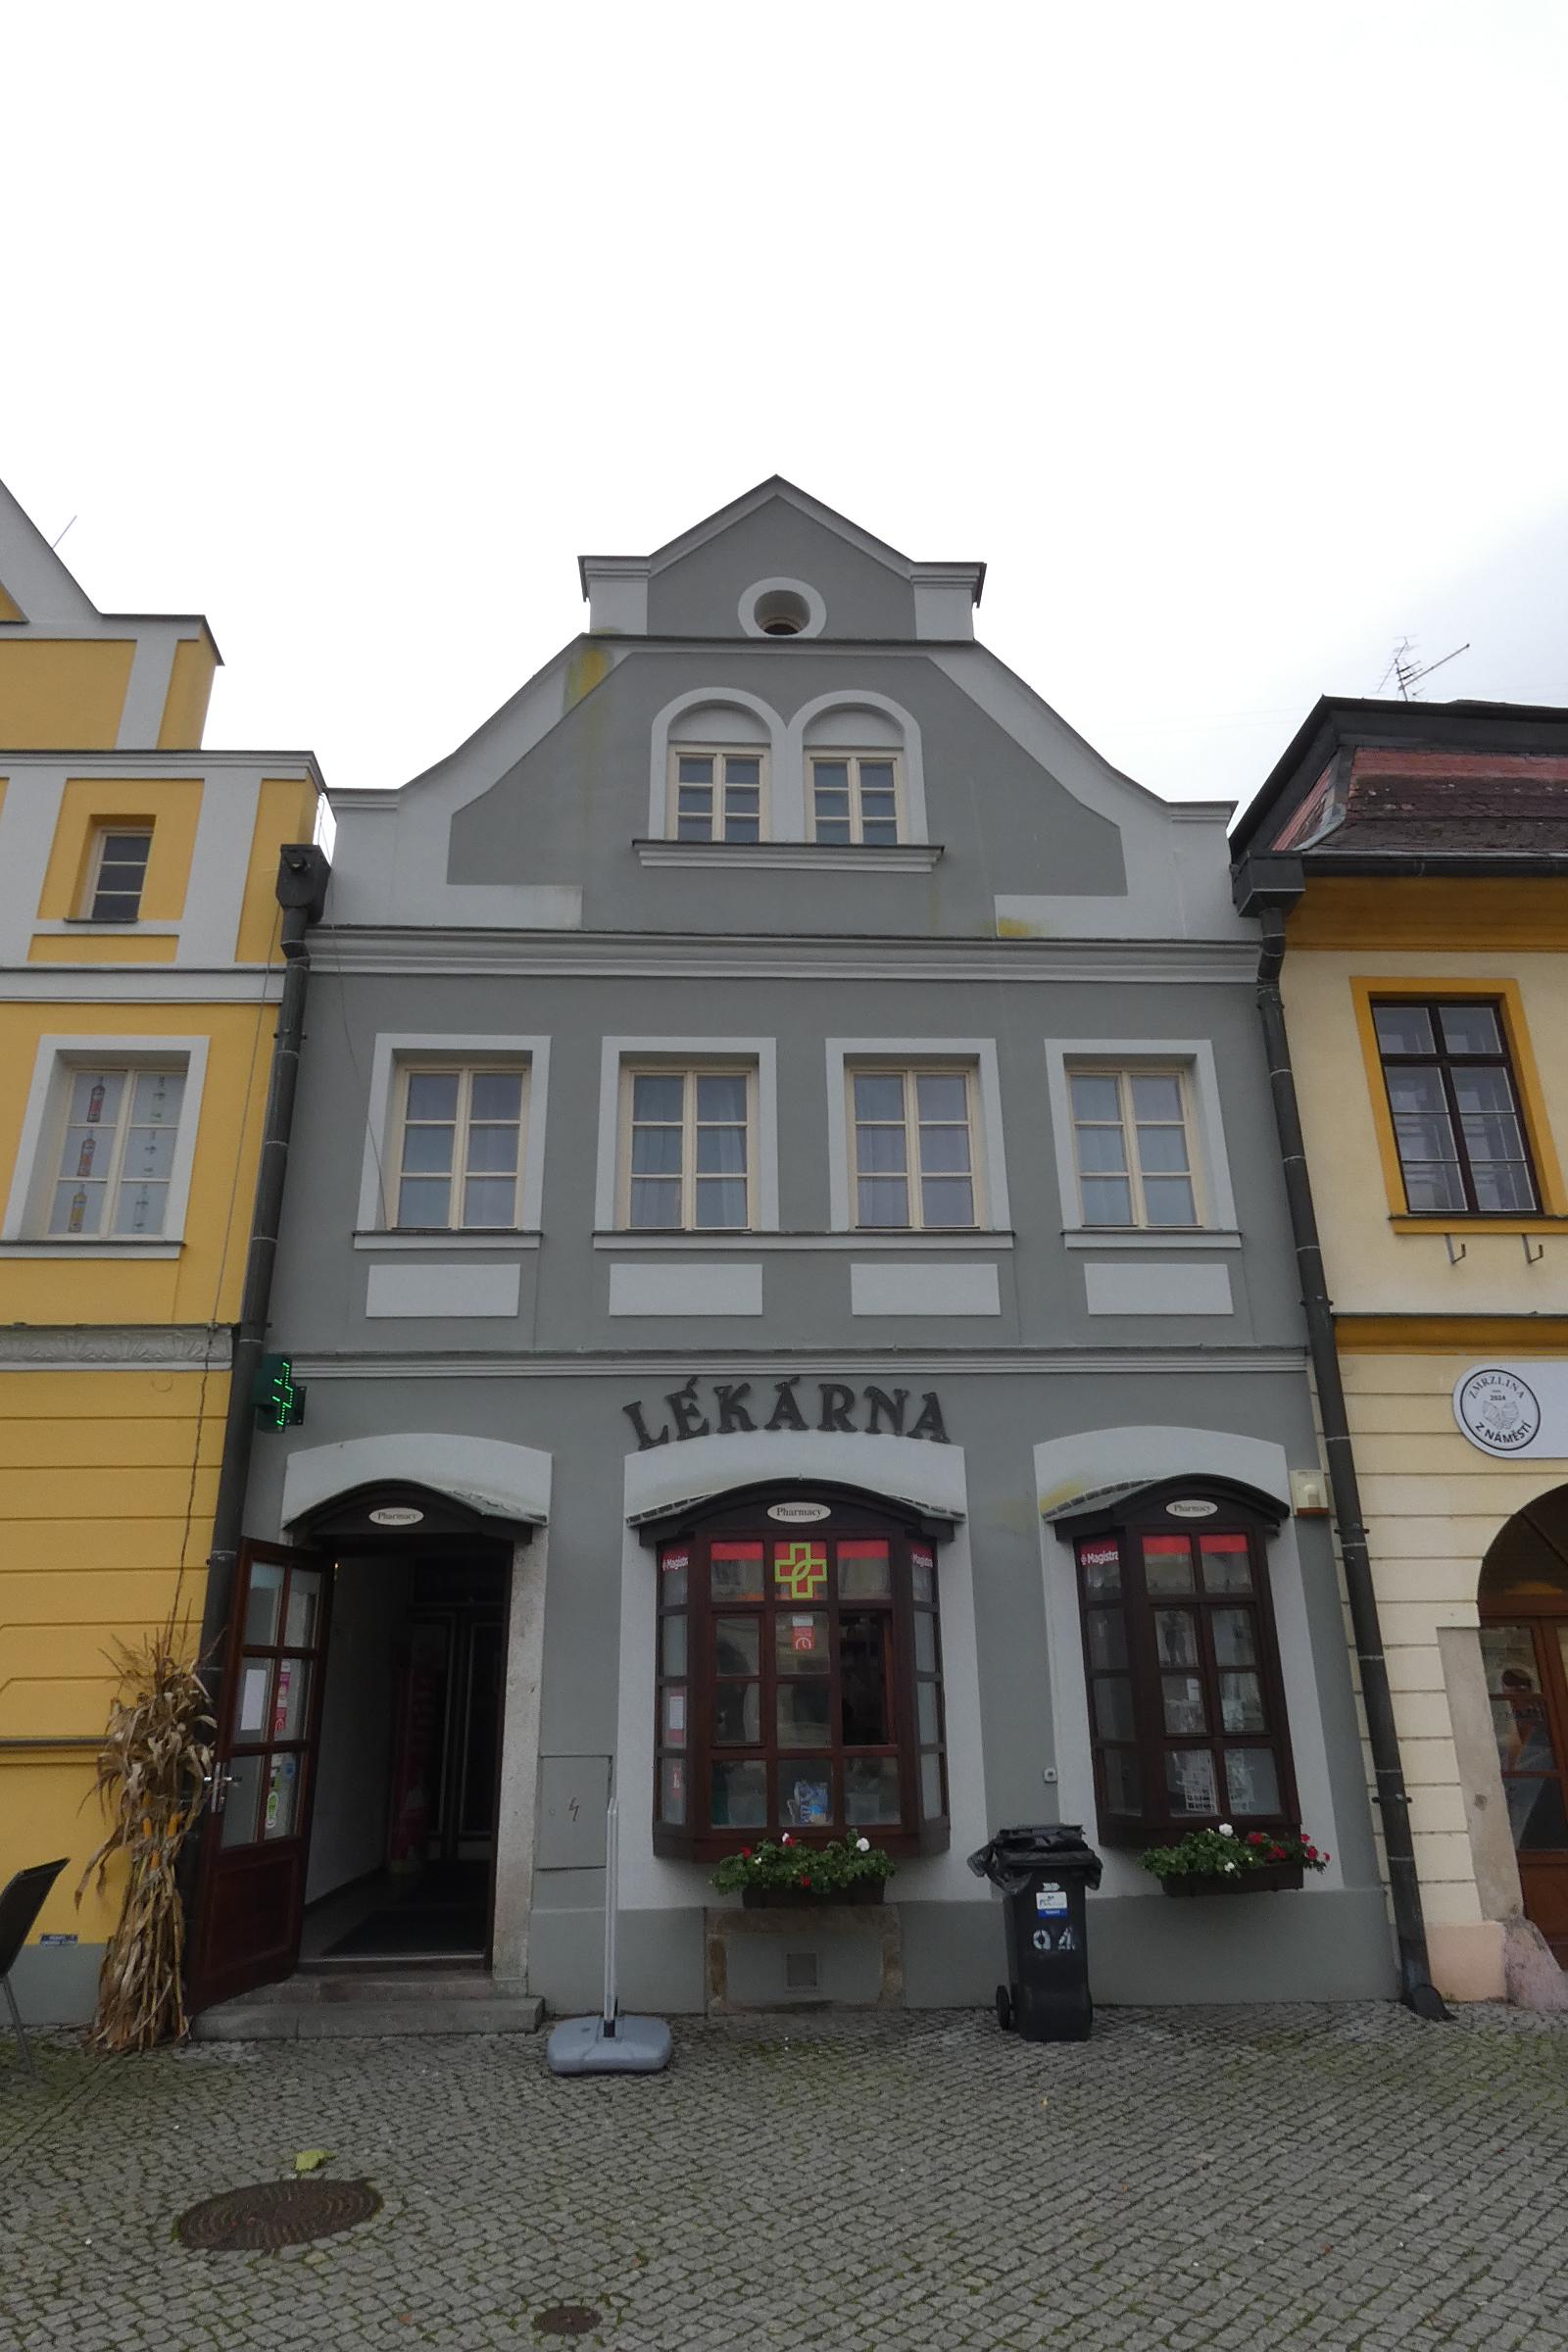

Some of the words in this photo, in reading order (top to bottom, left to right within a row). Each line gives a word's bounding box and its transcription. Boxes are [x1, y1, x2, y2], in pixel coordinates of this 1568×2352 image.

[1469, 1375, 1525, 1399] ZMRZLINA
[622, 1376, 952, 1451] LÉKÁRNA
[1485, 1419, 1532, 1444] NÁMĚSTÍ
[776, 1507, 822, 1519] Pharmacy
